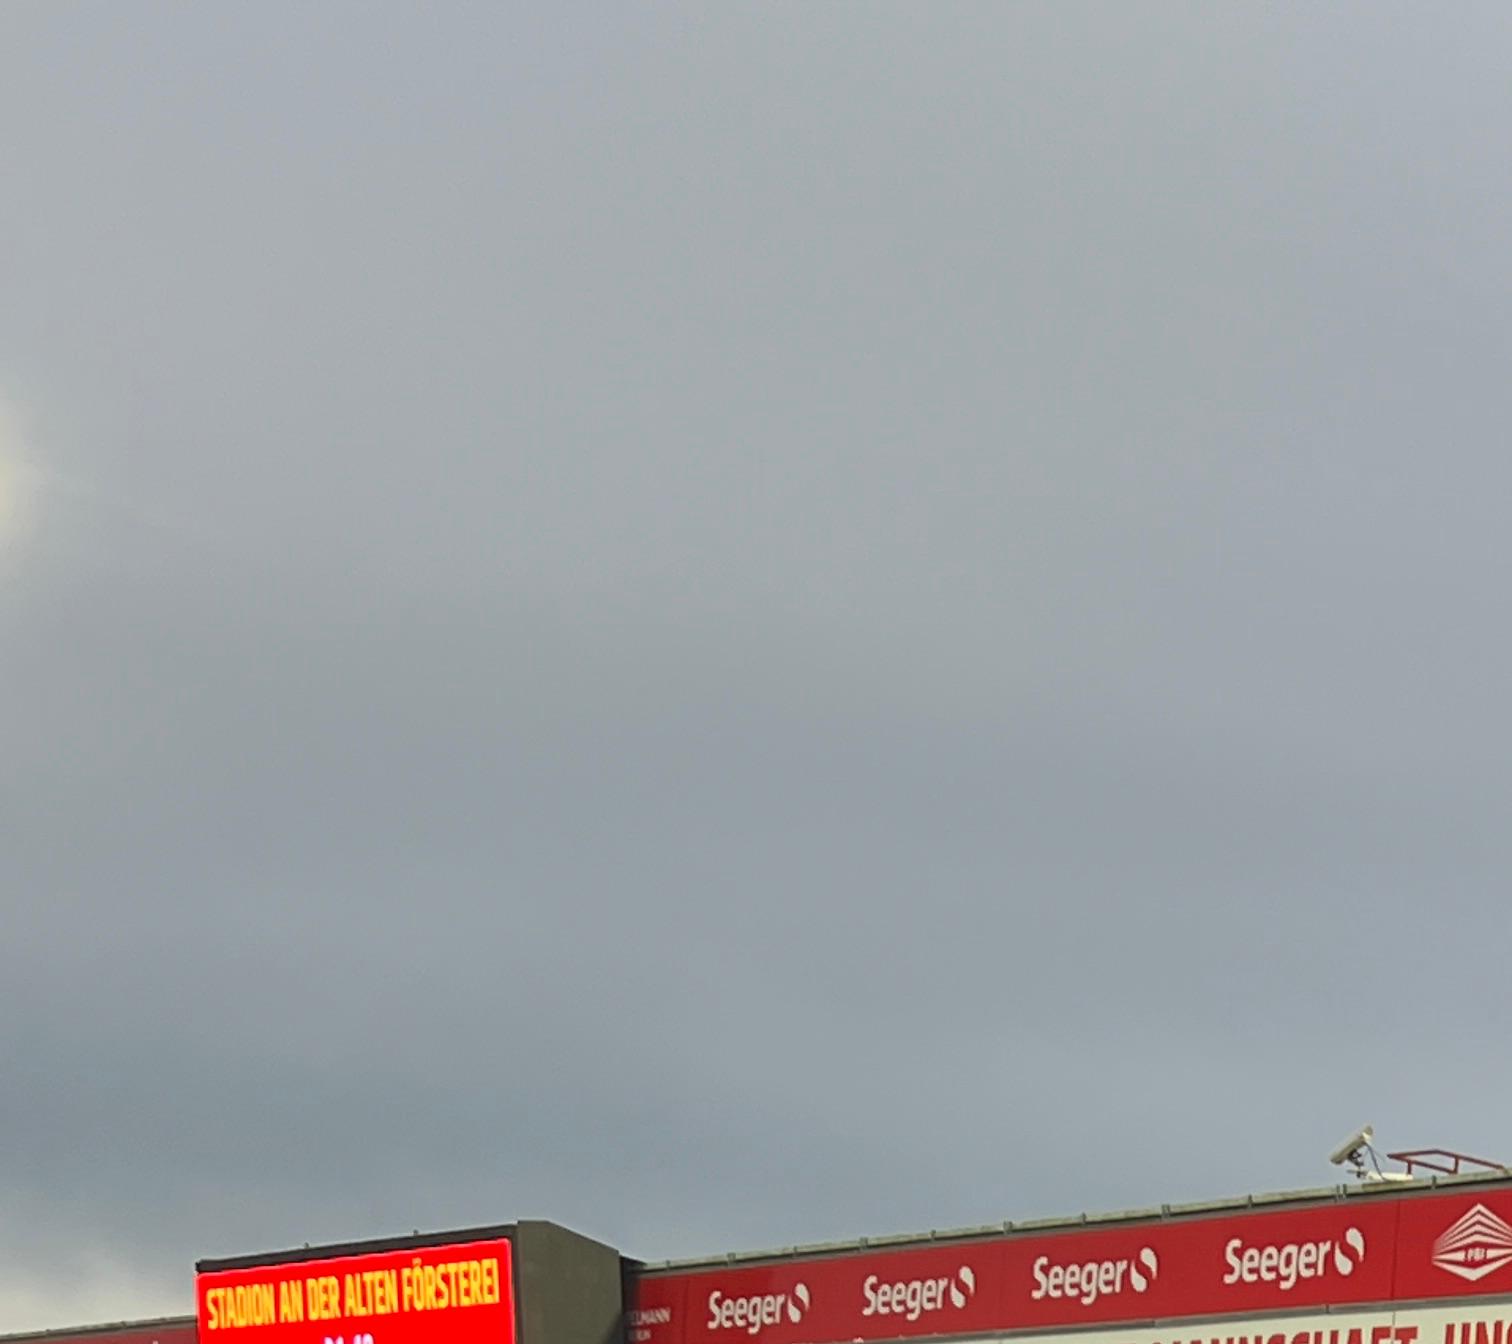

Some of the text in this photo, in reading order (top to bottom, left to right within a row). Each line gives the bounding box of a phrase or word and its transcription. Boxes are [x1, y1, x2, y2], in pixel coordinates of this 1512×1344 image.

[1031, 1256, 1128, 1305] Seeger
[1223, 1238, 1331, 1289] Seeger
[206, 1257, 500, 1329] STADION AN DER ALTEN FÖRSTEREI
[707, 1291, 786, 1334] Seeger
[862, 1275, 948, 1321] Seeger
